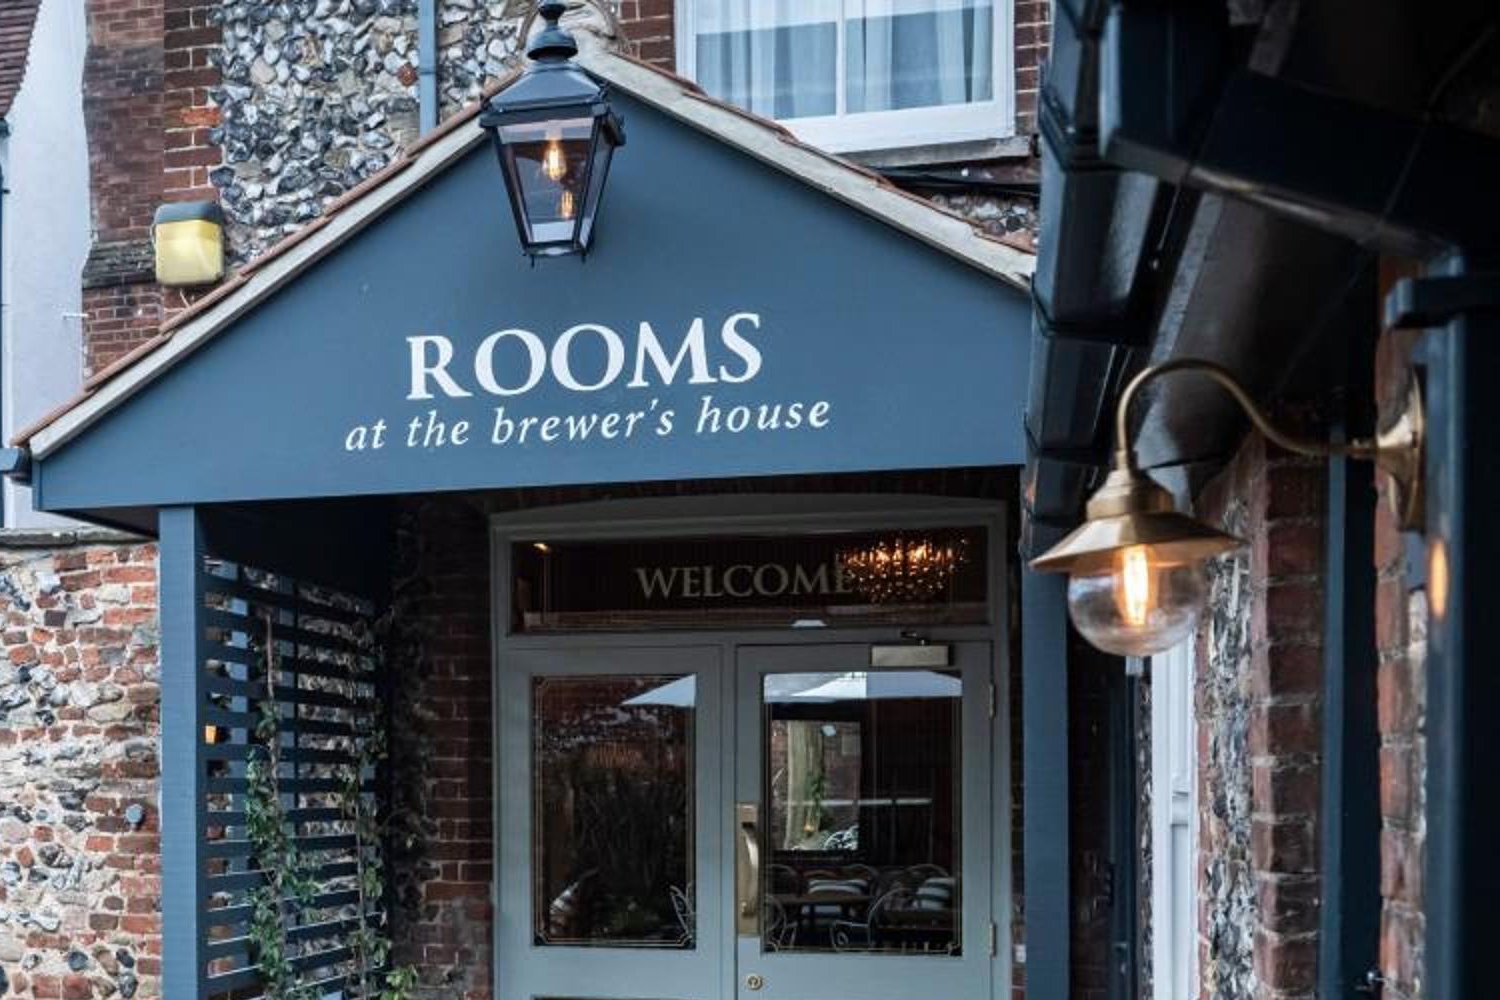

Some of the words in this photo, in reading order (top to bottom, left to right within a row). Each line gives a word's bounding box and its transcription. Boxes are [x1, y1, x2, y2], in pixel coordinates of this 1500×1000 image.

[405, 313, 762, 400] ROOMS
[345, 419, 387, 451] at
[407, 410, 469, 447] the
[491, 399, 675, 445] brewer's
[696, 396, 830, 433] house
[636, 563, 854, 598] WELCOME
